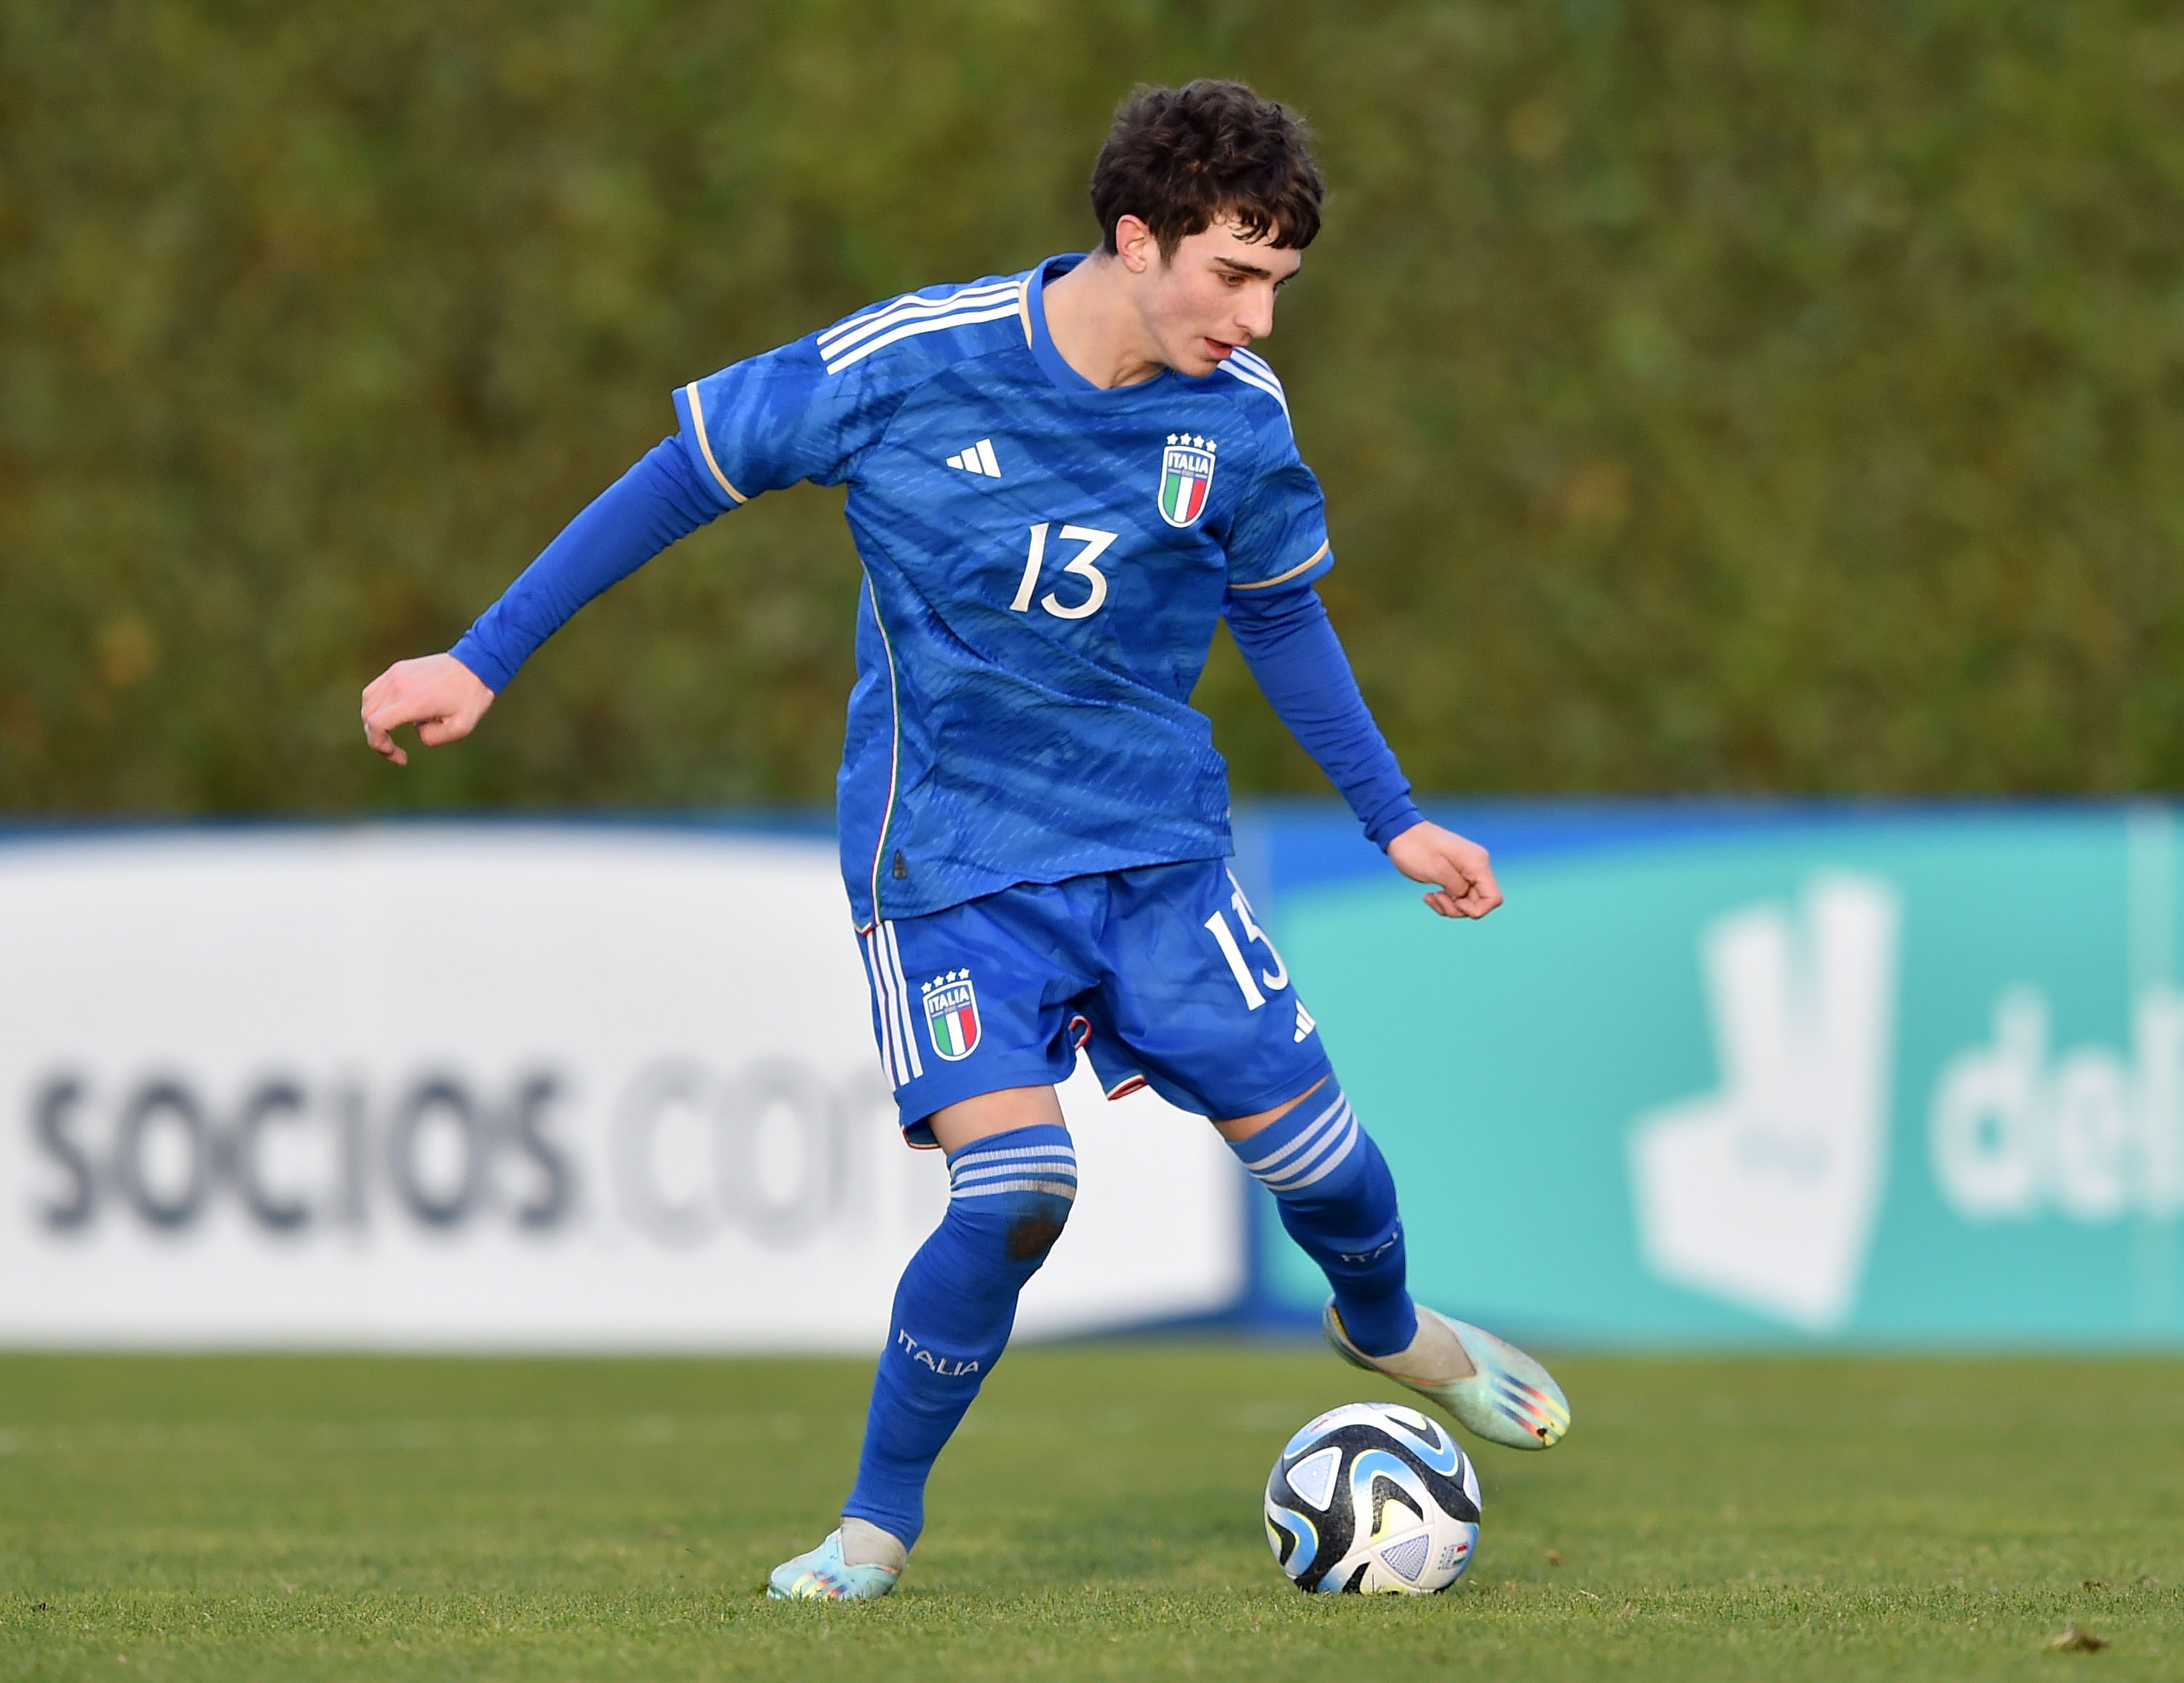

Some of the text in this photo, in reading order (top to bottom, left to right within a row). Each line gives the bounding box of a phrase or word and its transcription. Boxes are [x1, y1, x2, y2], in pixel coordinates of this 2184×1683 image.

[1168, 451, 1208, 474] ITALIA
[1009, 522, 1118, 619] 13
[928, 986, 970, 1014] ITALIA
[897, 1328, 980, 1377] ITALIA
